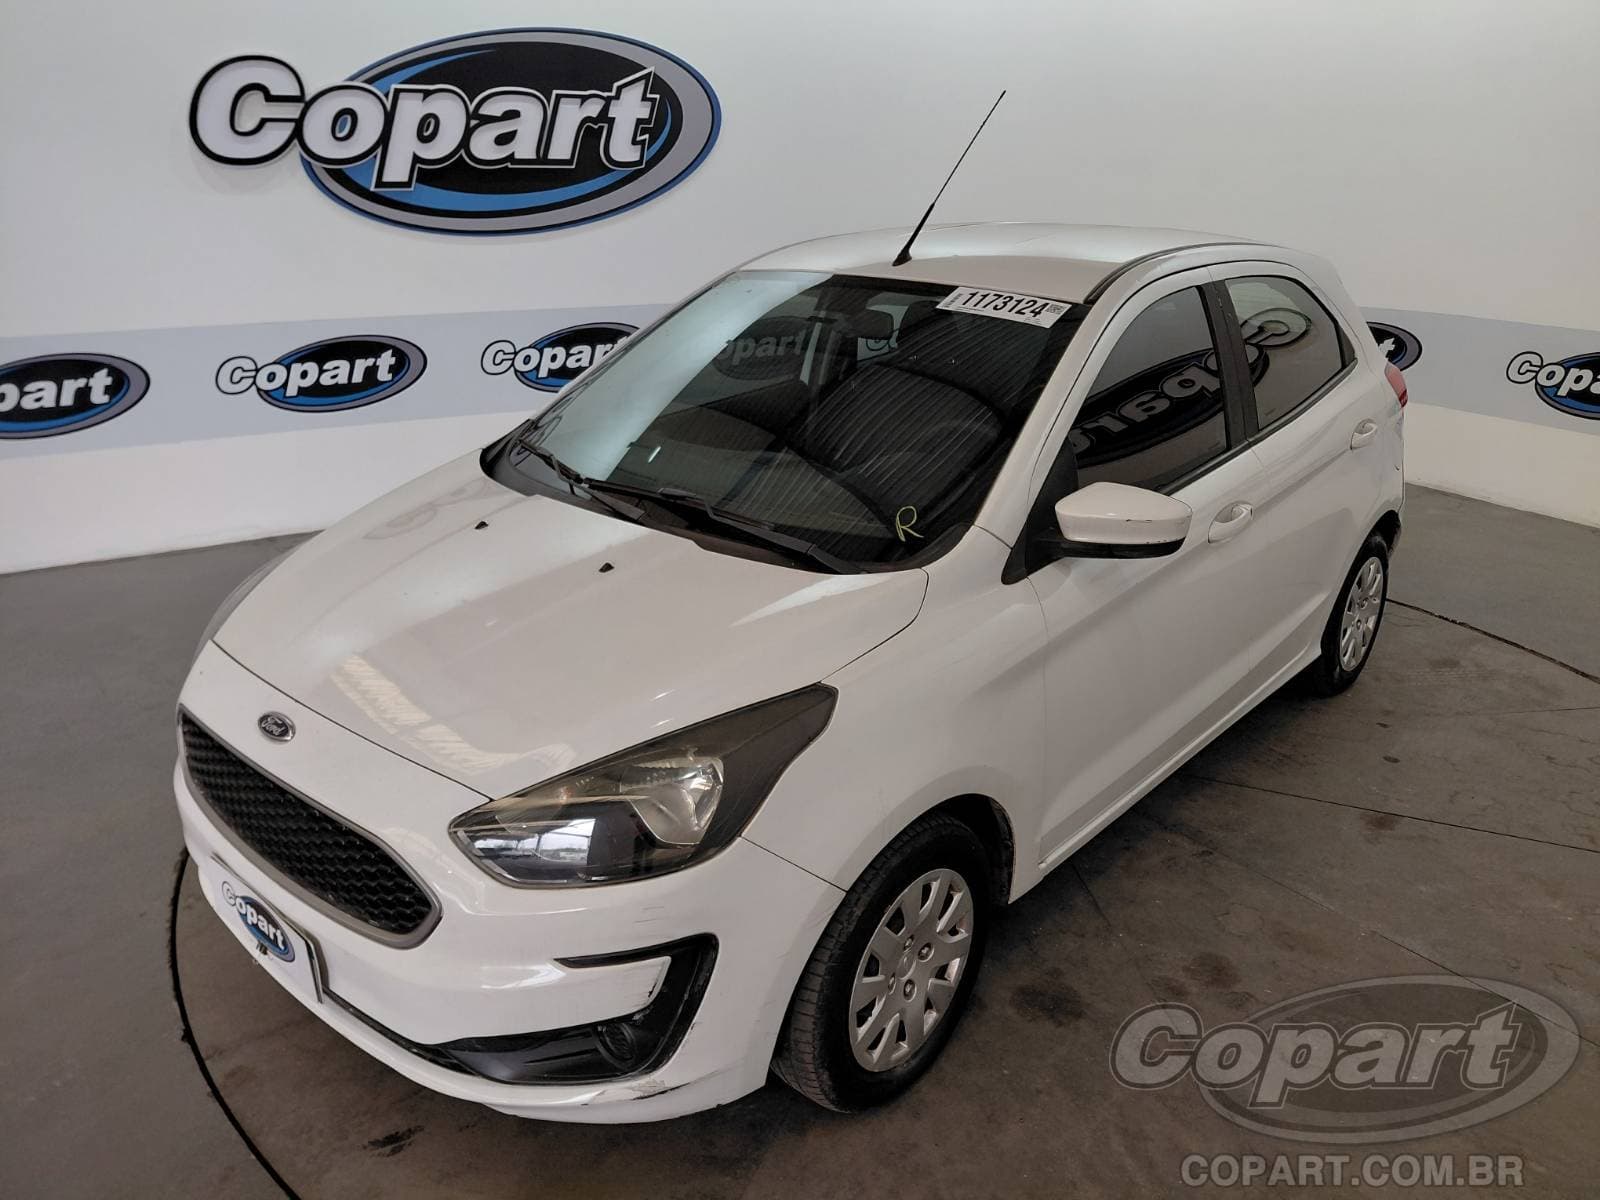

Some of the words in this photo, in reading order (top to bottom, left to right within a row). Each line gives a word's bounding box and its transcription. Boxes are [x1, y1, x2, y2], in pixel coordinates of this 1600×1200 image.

[189, 55, 660, 191] Copart
[961, 290, 1050, 319] 1173124
[215, 348, 397, 397] Copart
[480, 335, 629, 379] Copar
[1505, 350, 1600, 398] Cop
[895, 505, 925, 542] R
[261, 716, 287, 737] Ford
[221, 880, 286, 951] Copart
